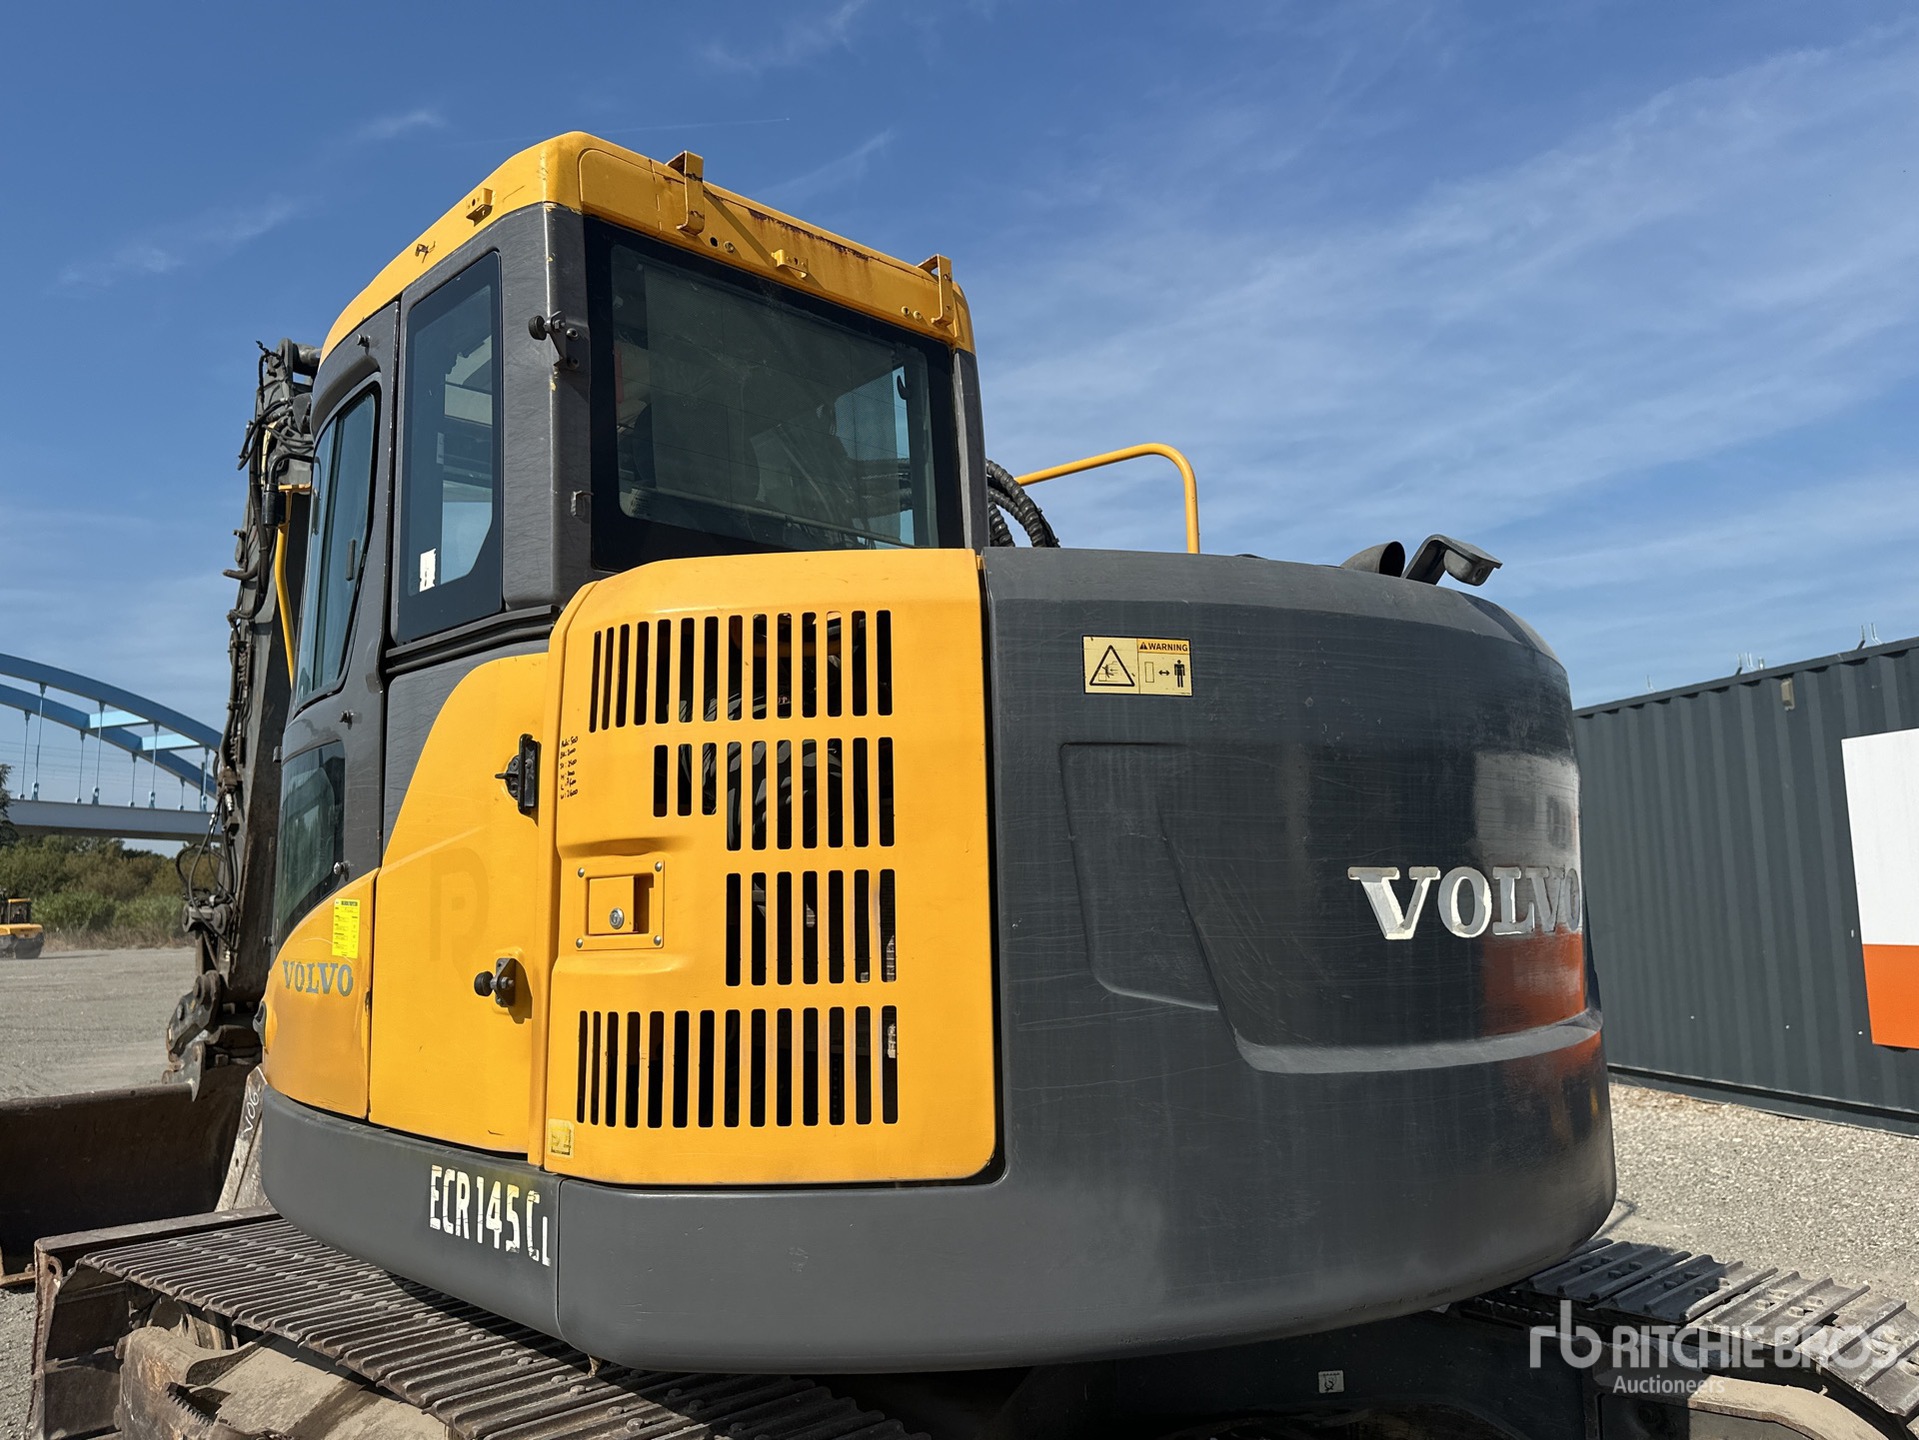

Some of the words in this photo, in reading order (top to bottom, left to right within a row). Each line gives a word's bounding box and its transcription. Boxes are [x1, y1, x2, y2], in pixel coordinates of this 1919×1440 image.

[1148, 642, 1188, 652] WARNING
[1347, 866, 1582, 940] VOLVO
[282, 960, 354, 997] VOLVO
